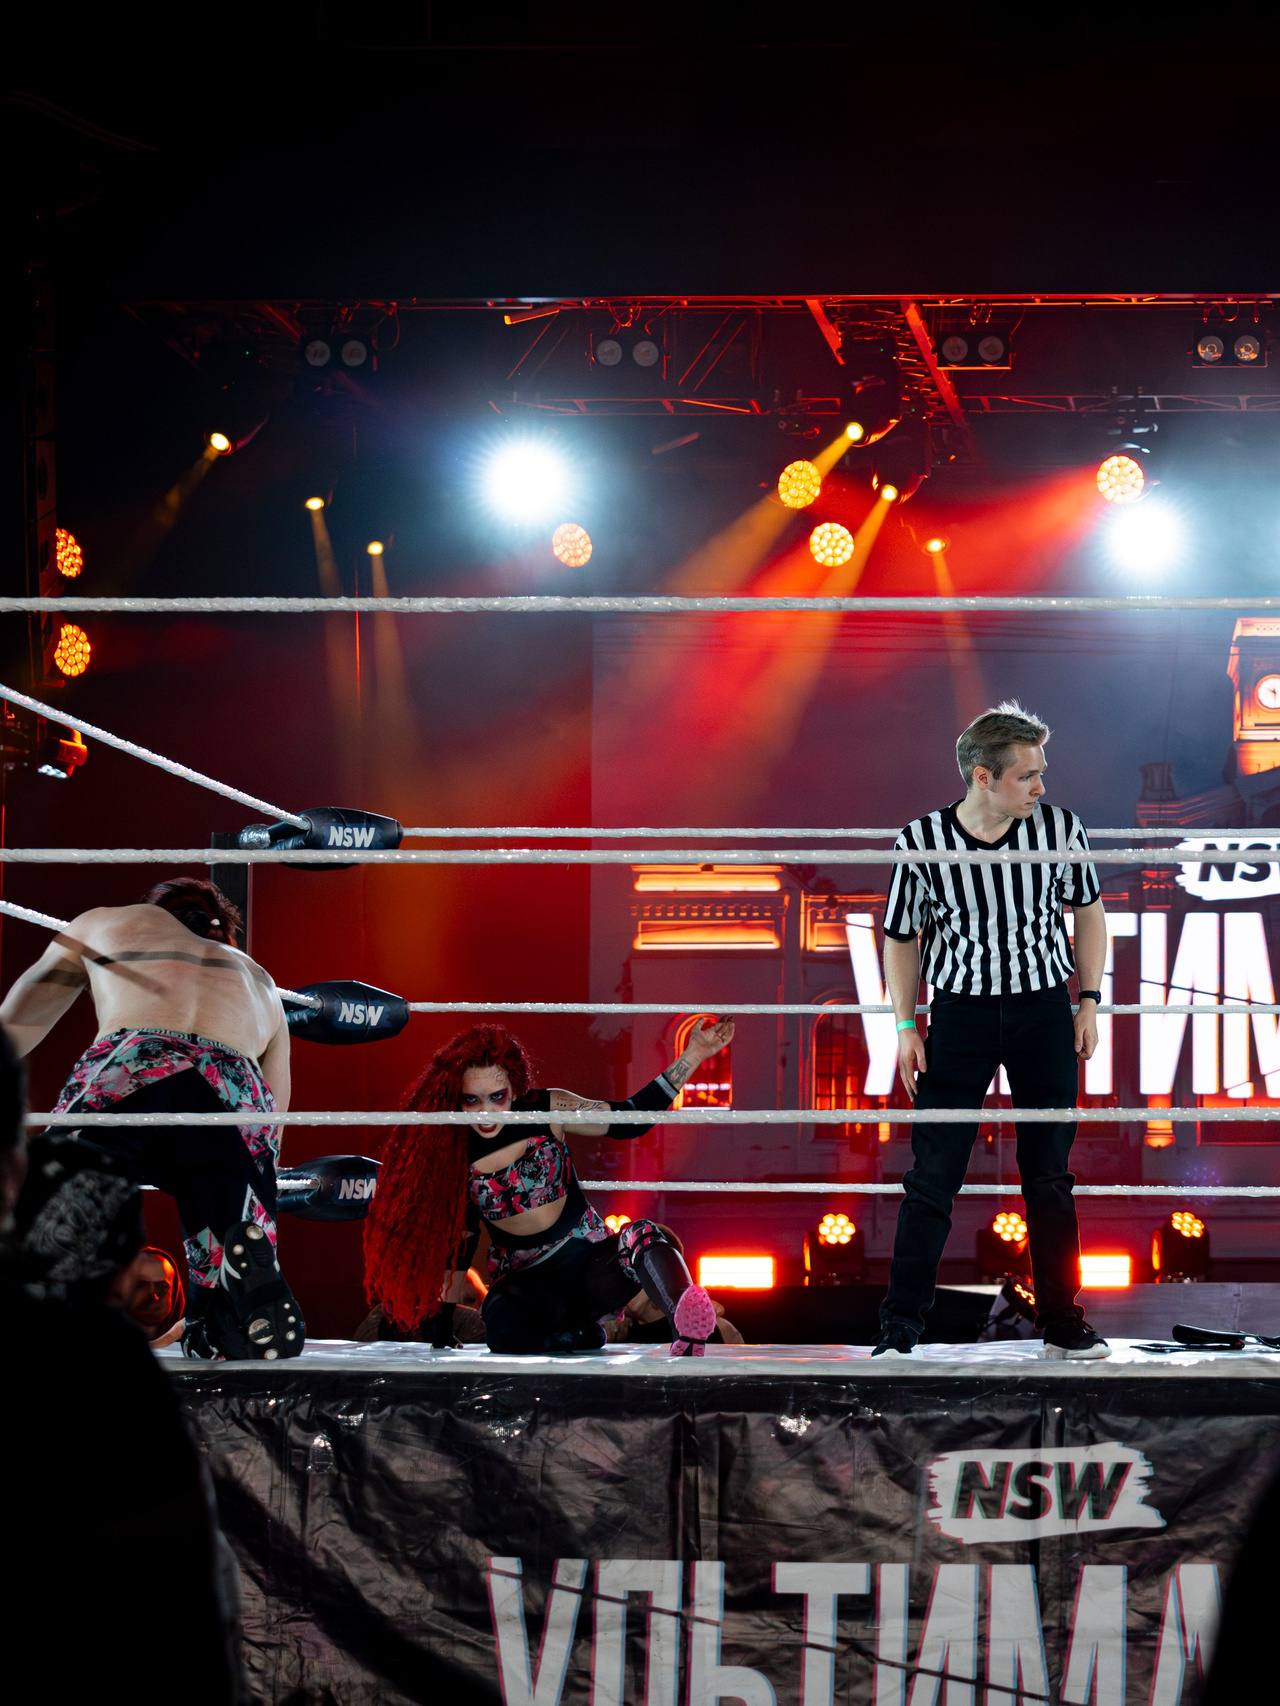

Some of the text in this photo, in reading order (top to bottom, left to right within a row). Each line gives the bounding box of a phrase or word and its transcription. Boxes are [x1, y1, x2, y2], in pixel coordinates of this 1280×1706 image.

[328, 826, 375, 847] NSW
[338, 1002, 384, 1026] NSW
[951, 1461, 1133, 1519] NSW
